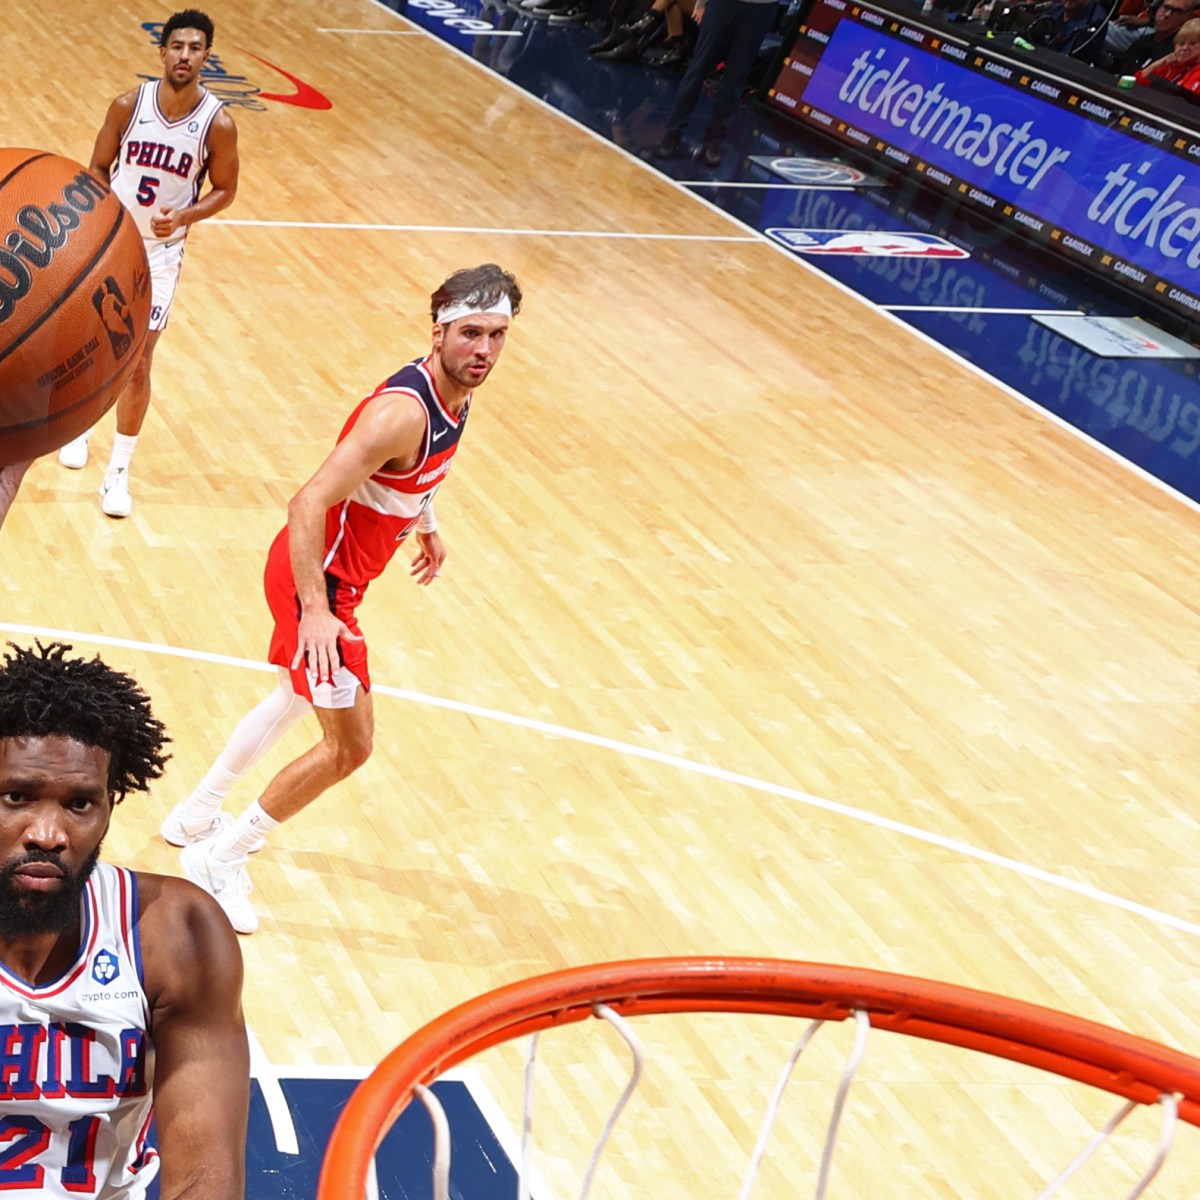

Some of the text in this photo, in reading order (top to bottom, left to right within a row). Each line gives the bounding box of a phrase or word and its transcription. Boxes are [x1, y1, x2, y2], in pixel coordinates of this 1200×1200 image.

[838, 48, 1071, 190] ticketmaster
[125, 140, 193, 178] PHILA
[136, 175, 161, 207] 5
[150, 305, 162, 321] 6
